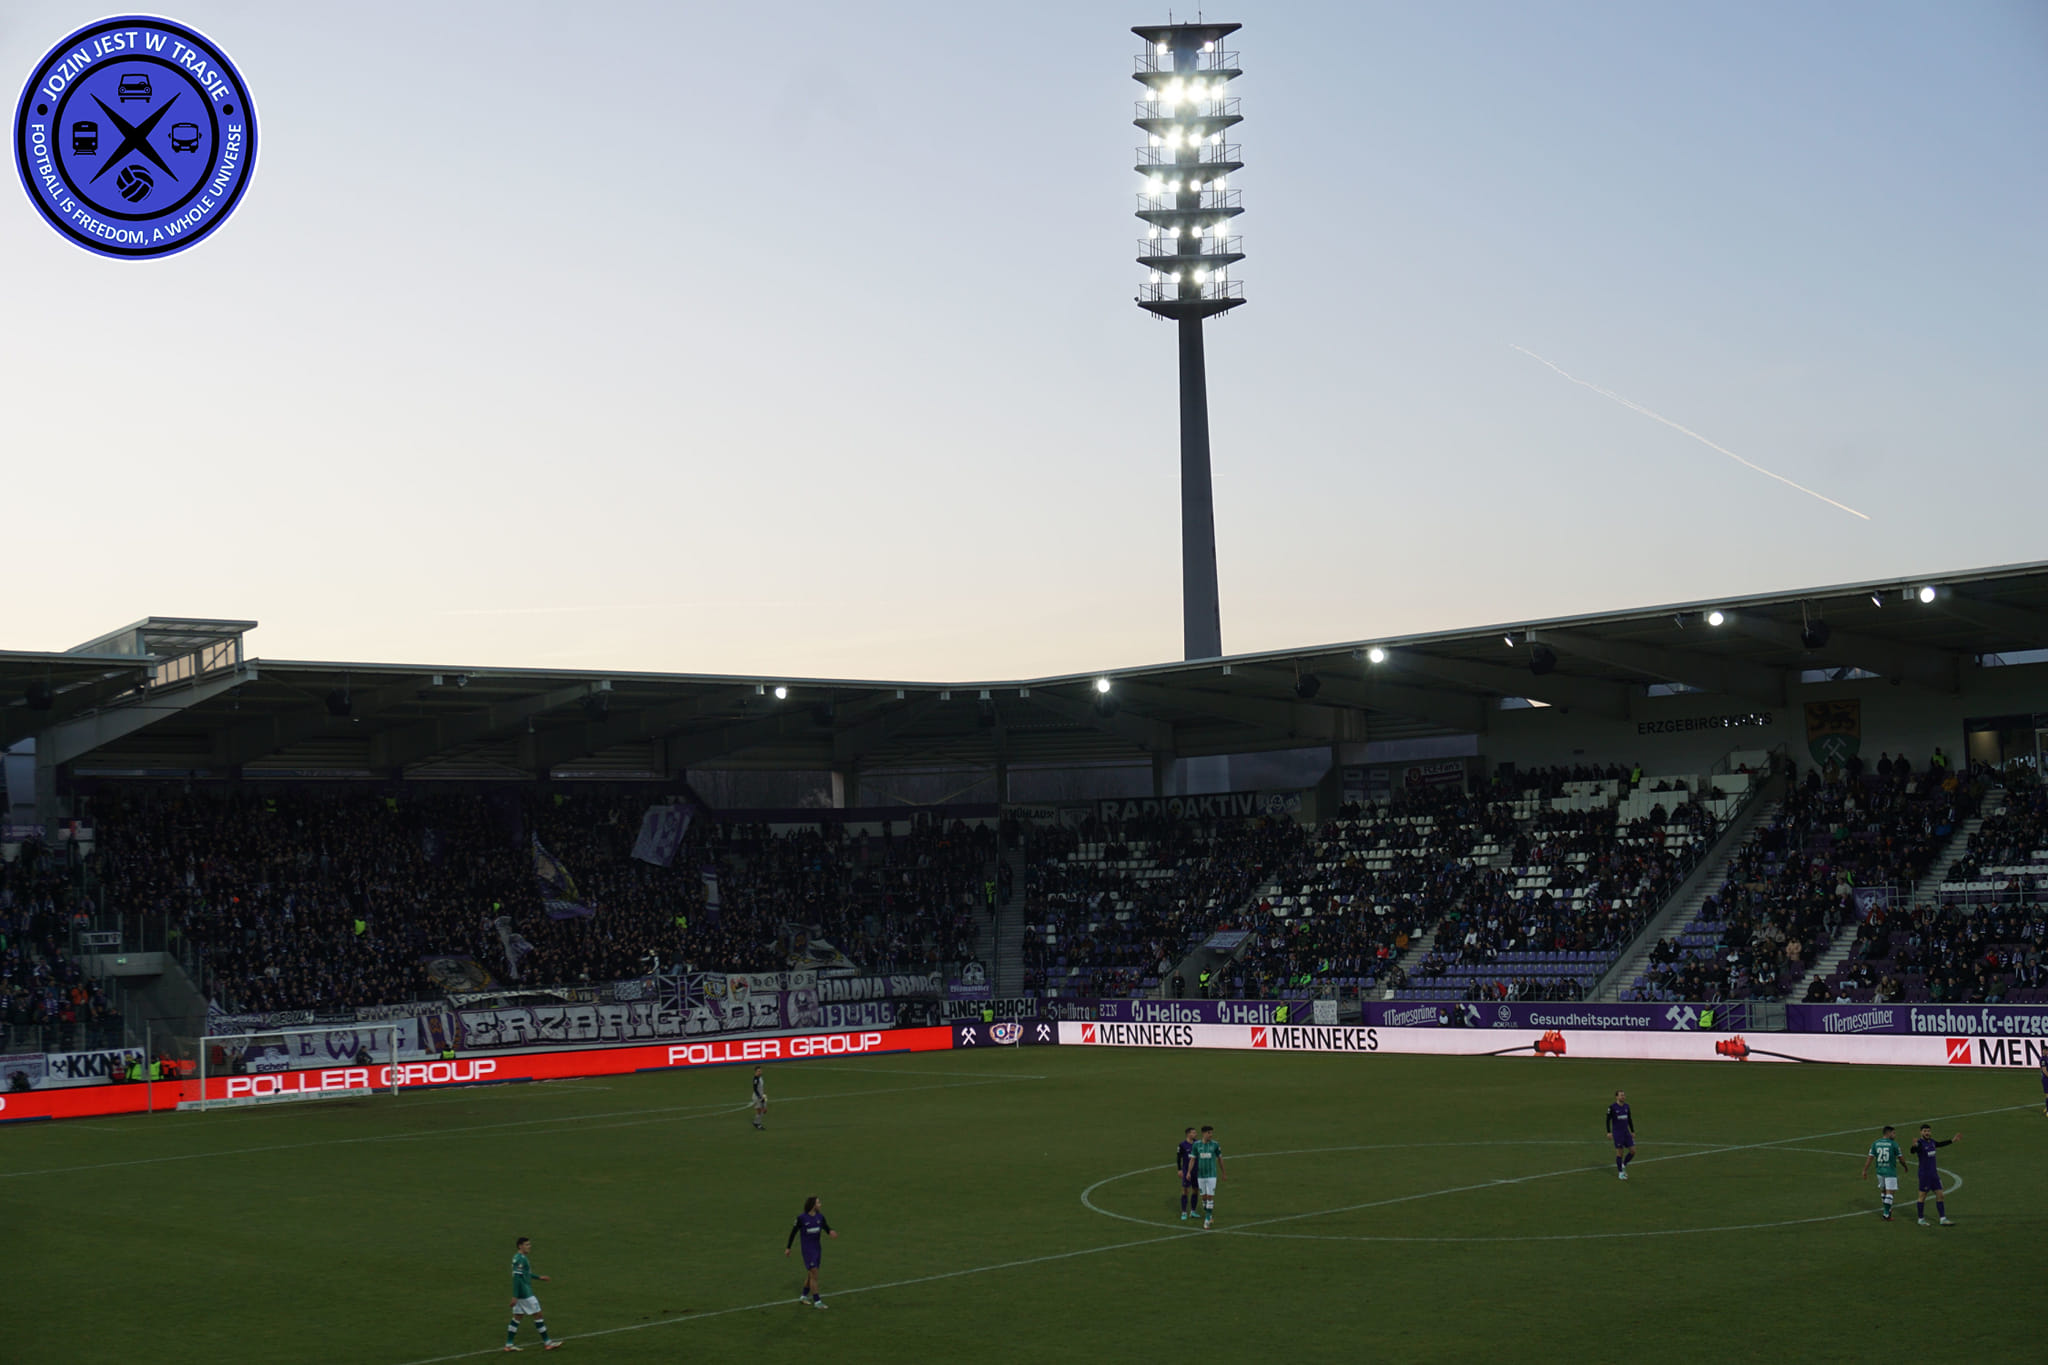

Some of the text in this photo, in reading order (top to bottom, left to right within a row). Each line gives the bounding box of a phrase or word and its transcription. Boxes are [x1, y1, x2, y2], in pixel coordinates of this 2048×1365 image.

[1638, 711, 1773, 734] ERZGEBIRGSKREIS
[1101, 793, 1255, 823] RADIOAKTIV
[461, 993, 779, 1045] ERZBRIGADE
[1147, 1004, 1201, 1023] Helios
[1529, 1012, 1650, 1030] Gesundheitspartner
[1100, 1023, 1193, 1046] MENNEKES
[1272, 1026, 1378, 1050] MENNEKES
[668, 1033, 881, 1065] POLLER GROUP
[227, 1068, 369, 1098] POLLER
[381, 1059, 496, 1086] GROUP
[1876, 1147, 1890, 1163] 25
